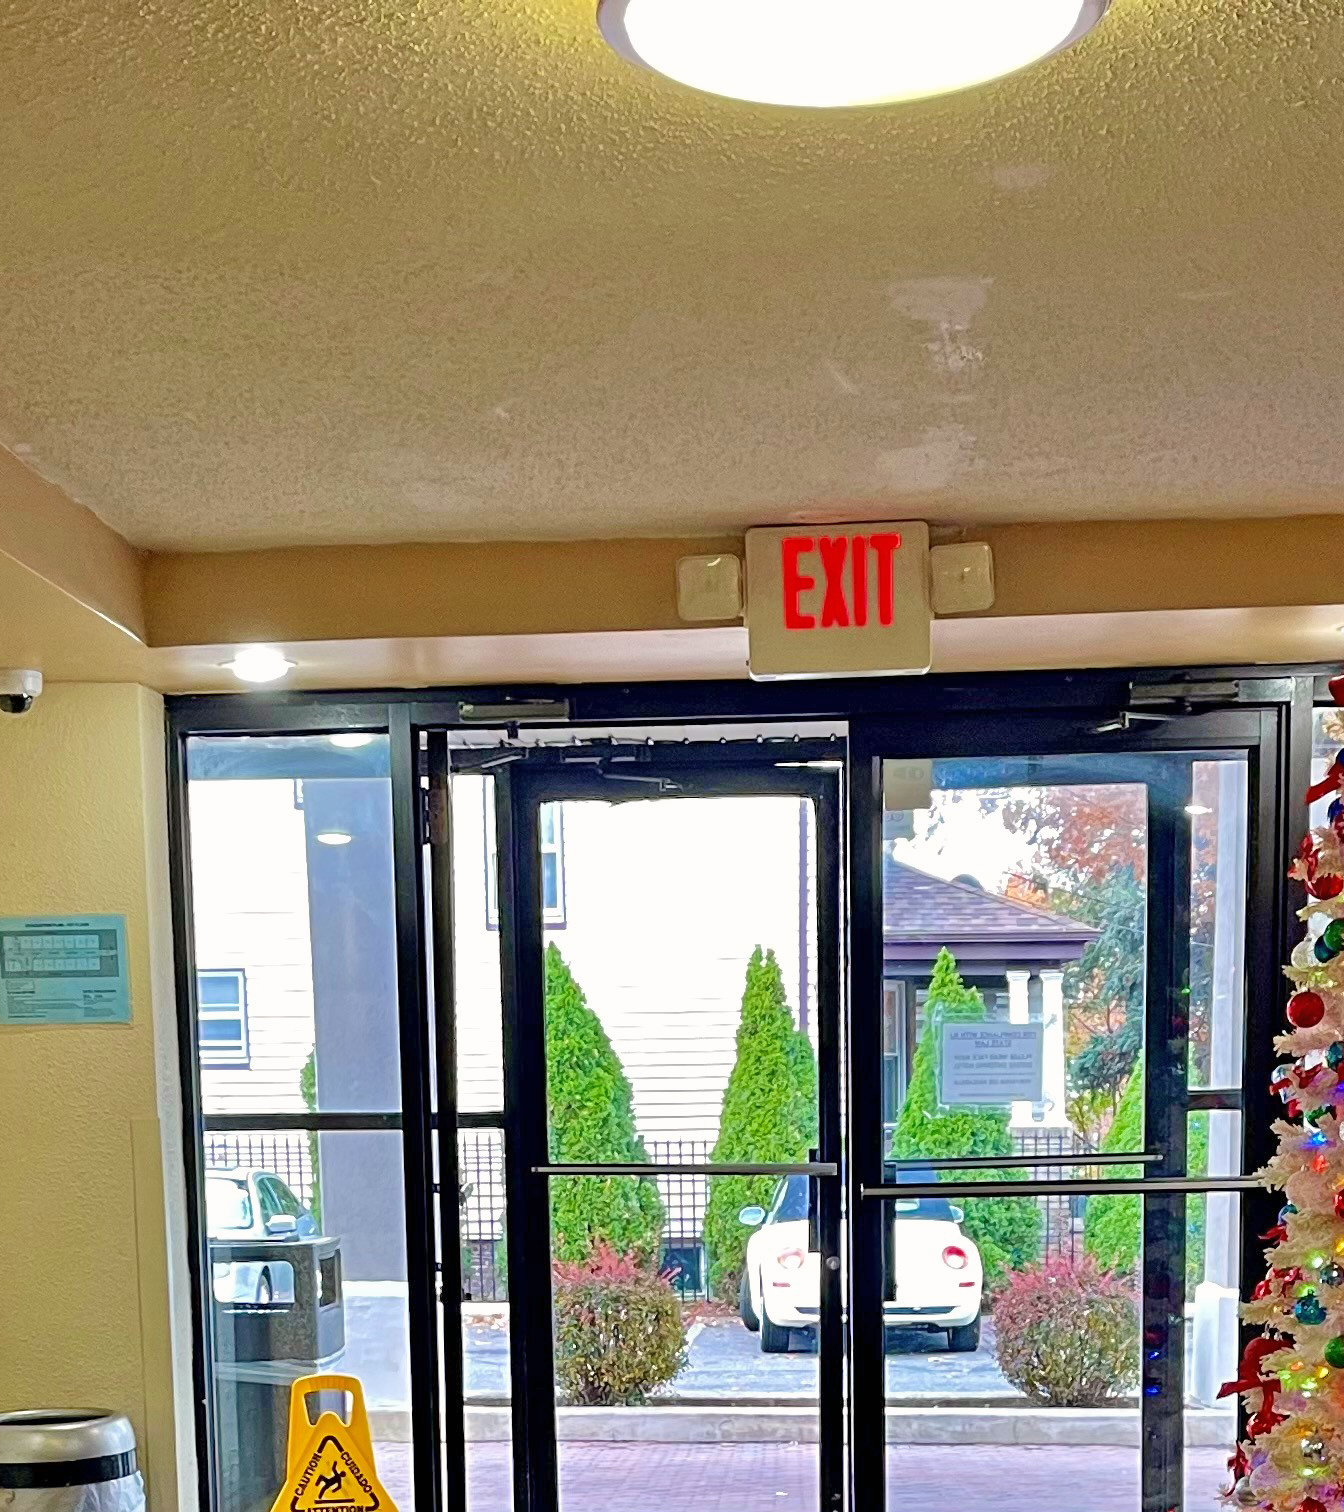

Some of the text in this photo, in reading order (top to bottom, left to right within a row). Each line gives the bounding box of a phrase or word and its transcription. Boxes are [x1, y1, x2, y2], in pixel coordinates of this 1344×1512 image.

[781, 532, 902, 630] EXIT
[294, 1452, 323, 1496] CAUTION
[340, 1451, 373, 1494] CUIDADO
